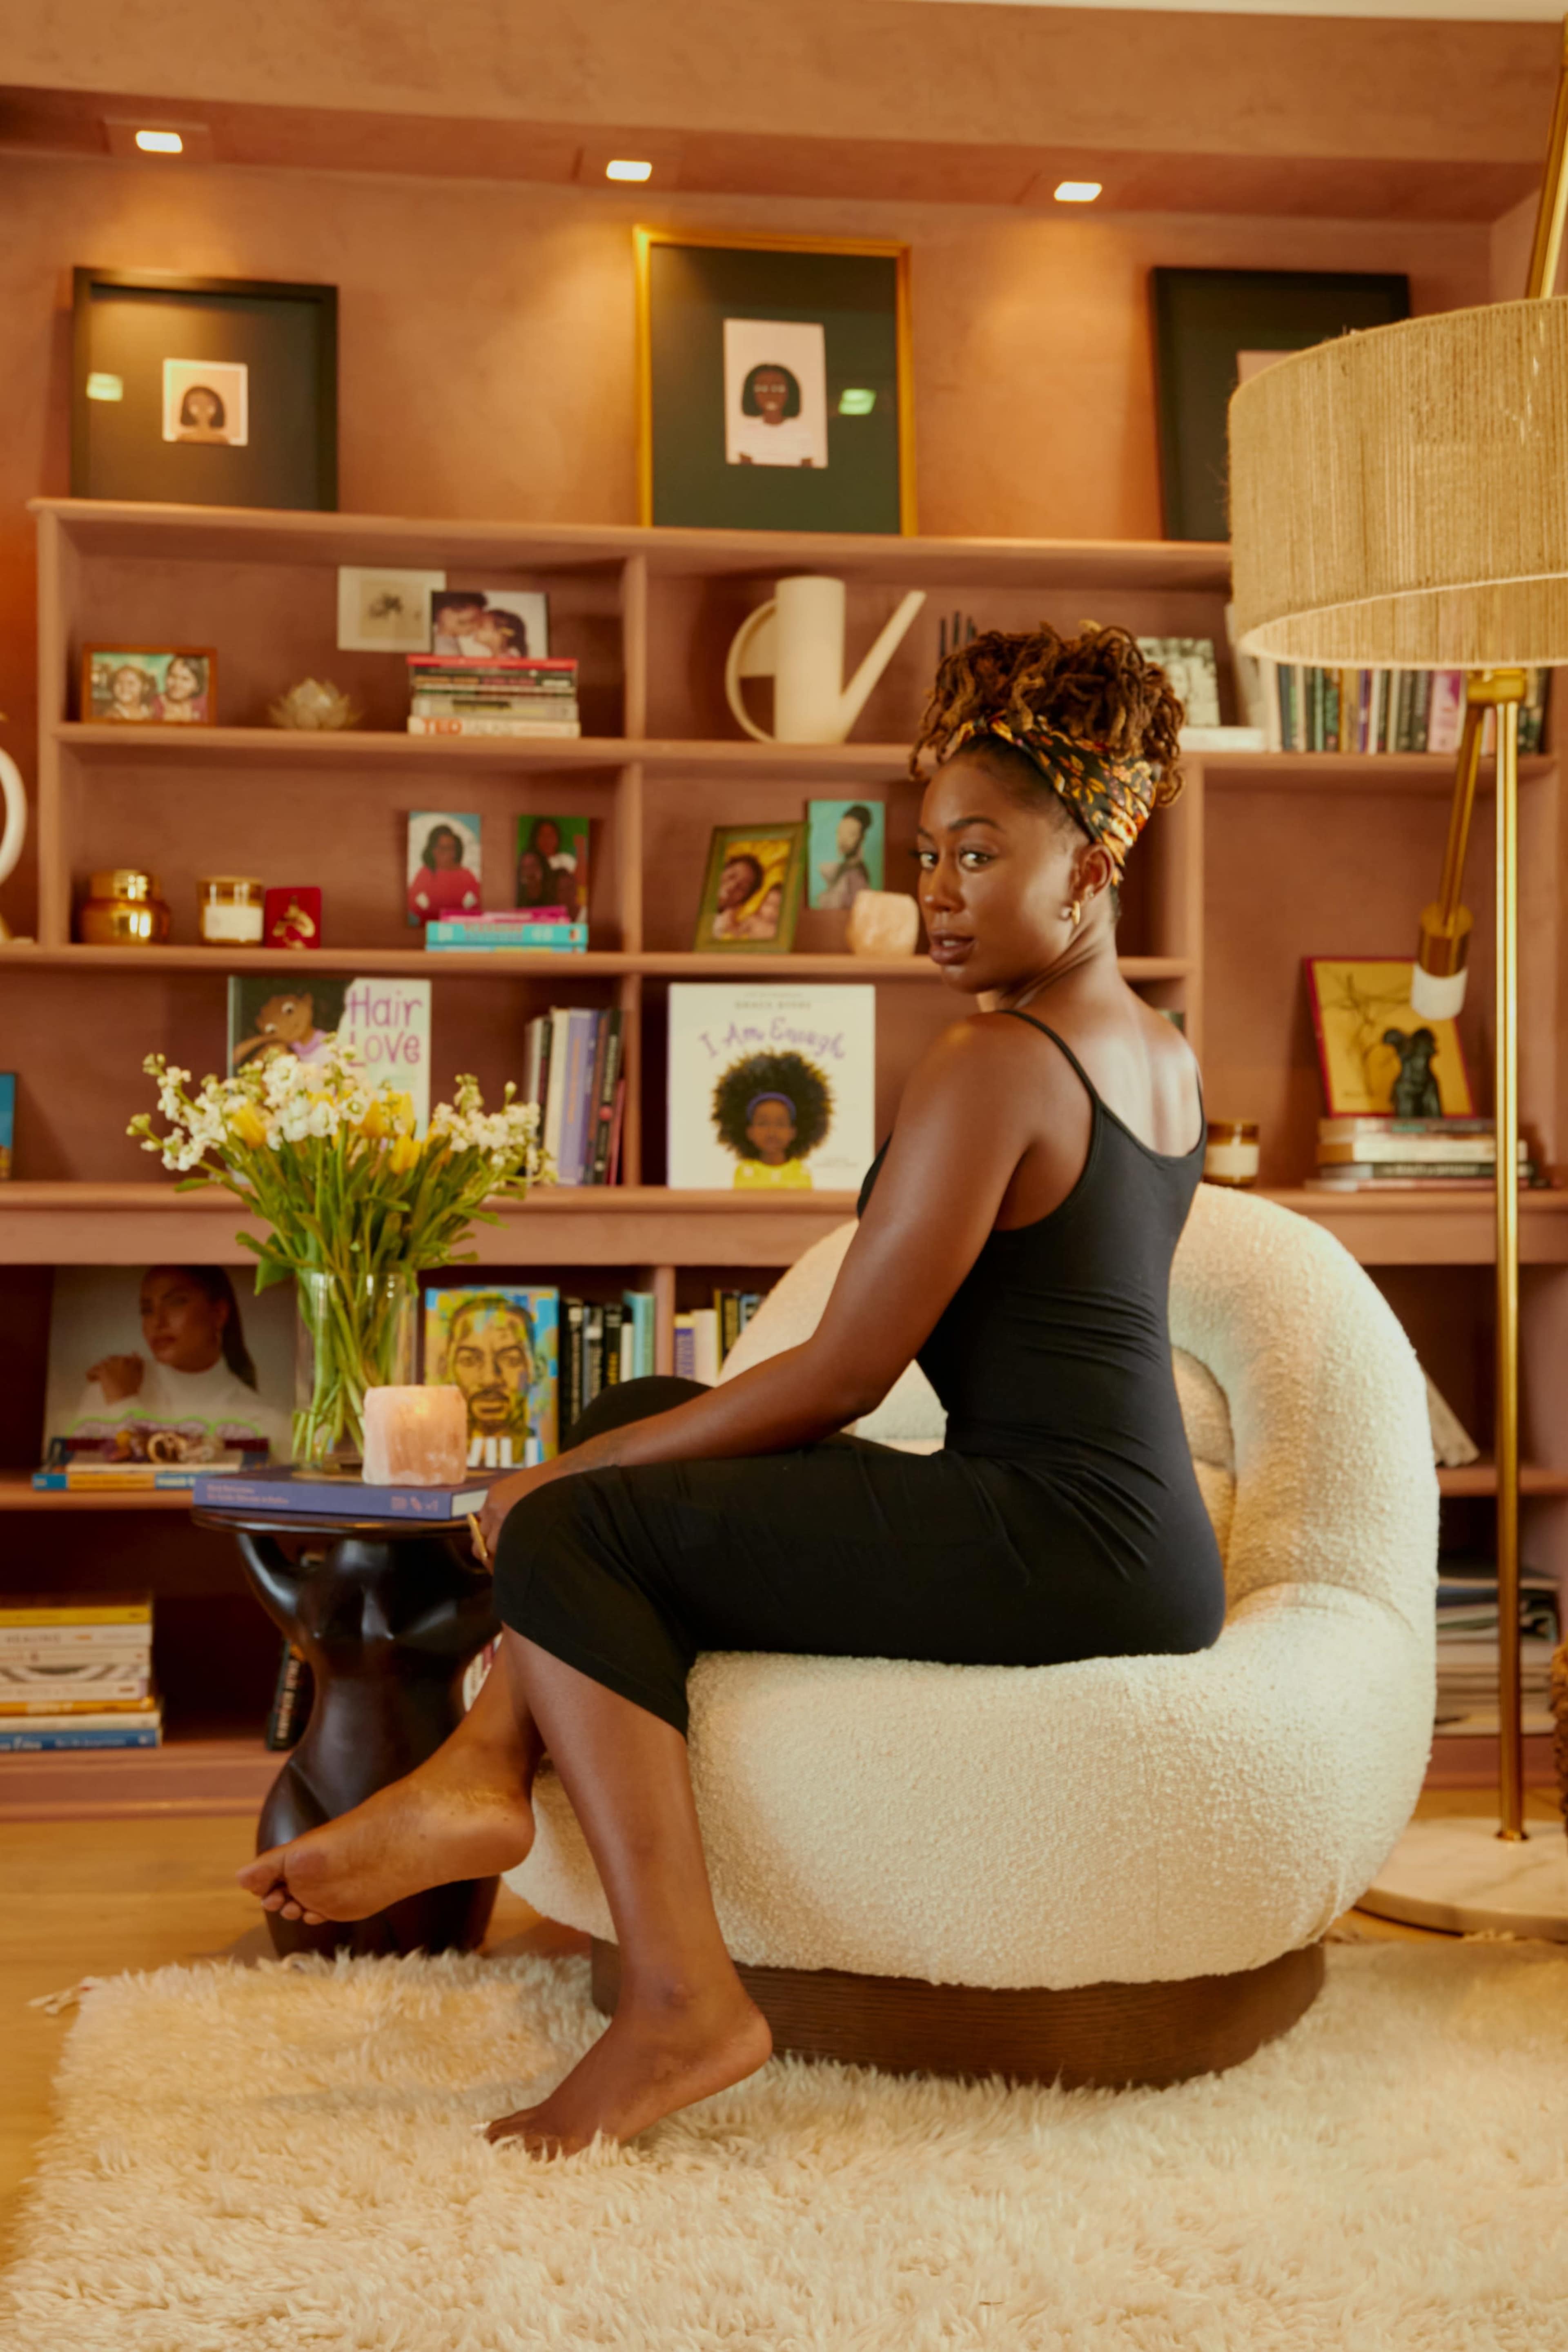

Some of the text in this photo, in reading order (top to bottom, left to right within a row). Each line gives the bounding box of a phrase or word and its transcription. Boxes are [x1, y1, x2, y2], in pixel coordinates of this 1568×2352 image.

[422, 717, 462, 735] TED
[349, 985, 423, 1027] Hair
[348, 1030, 421, 1067] Love
[699, 1031, 719, 1058] I
[722, 1021, 765, 1048] Am
